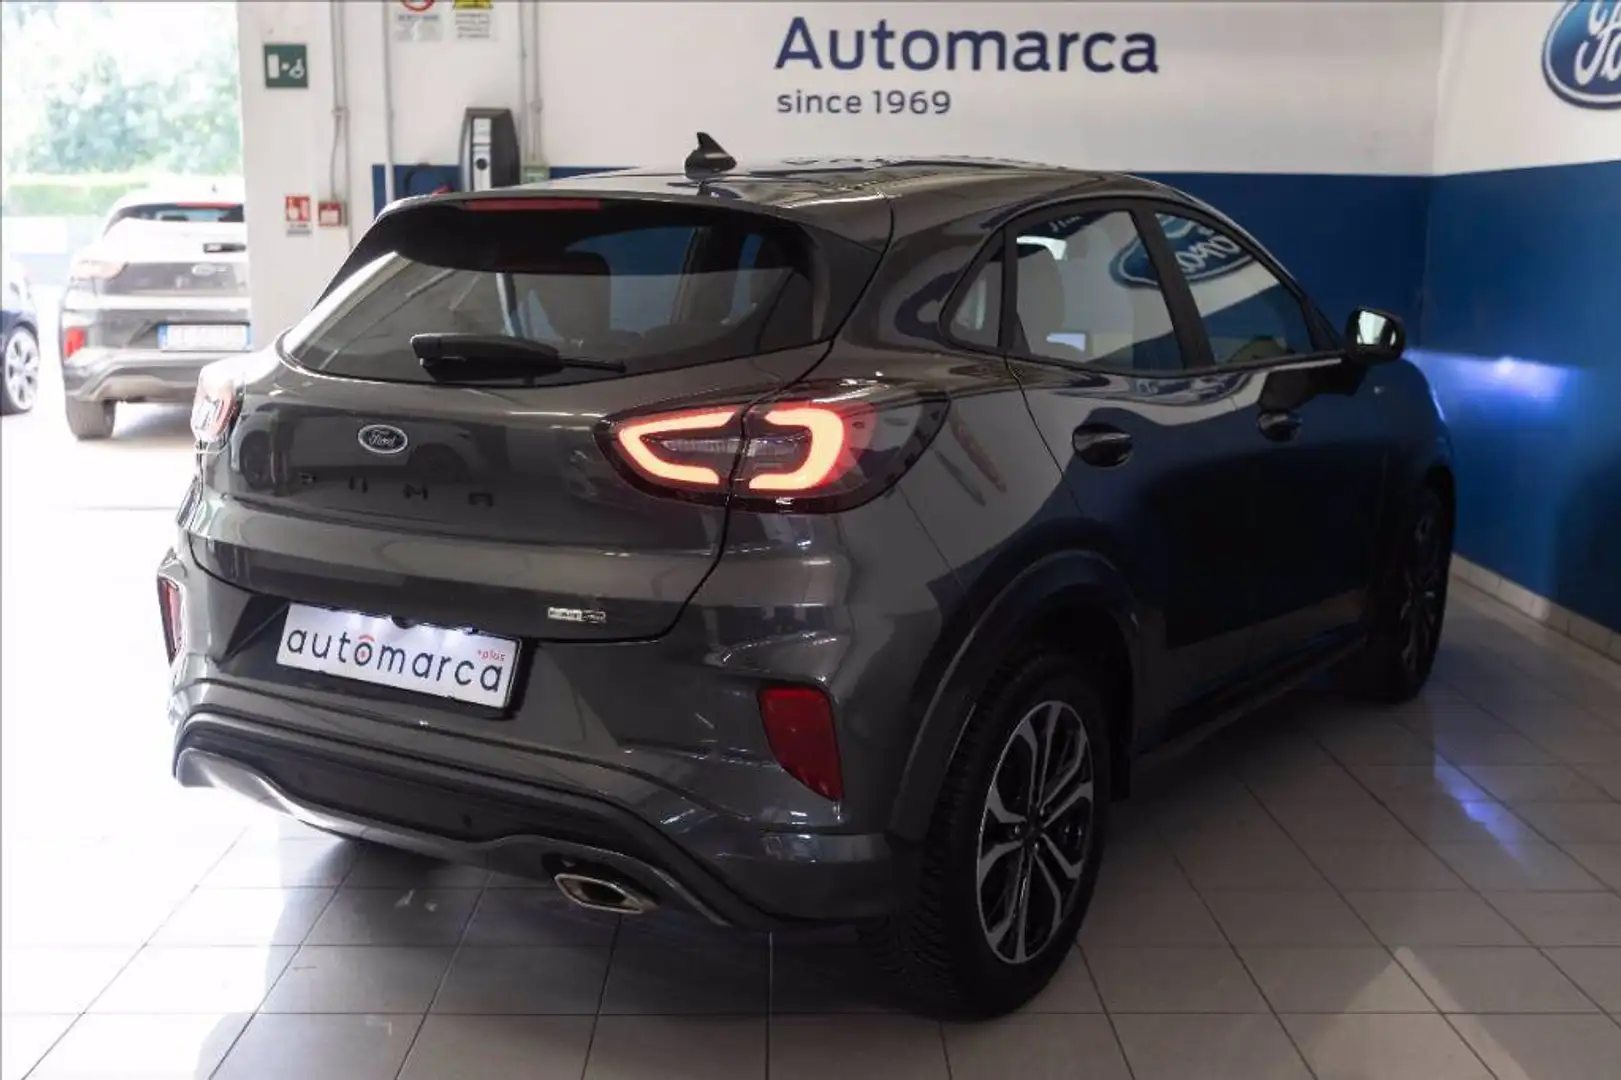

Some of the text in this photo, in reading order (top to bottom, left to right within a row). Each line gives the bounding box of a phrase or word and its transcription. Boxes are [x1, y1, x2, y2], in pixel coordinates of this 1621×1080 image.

[774, 16, 1160, 74] Automarca
[777, 90, 951, 116] since 1969
[286, 627, 504, 692] automarca
